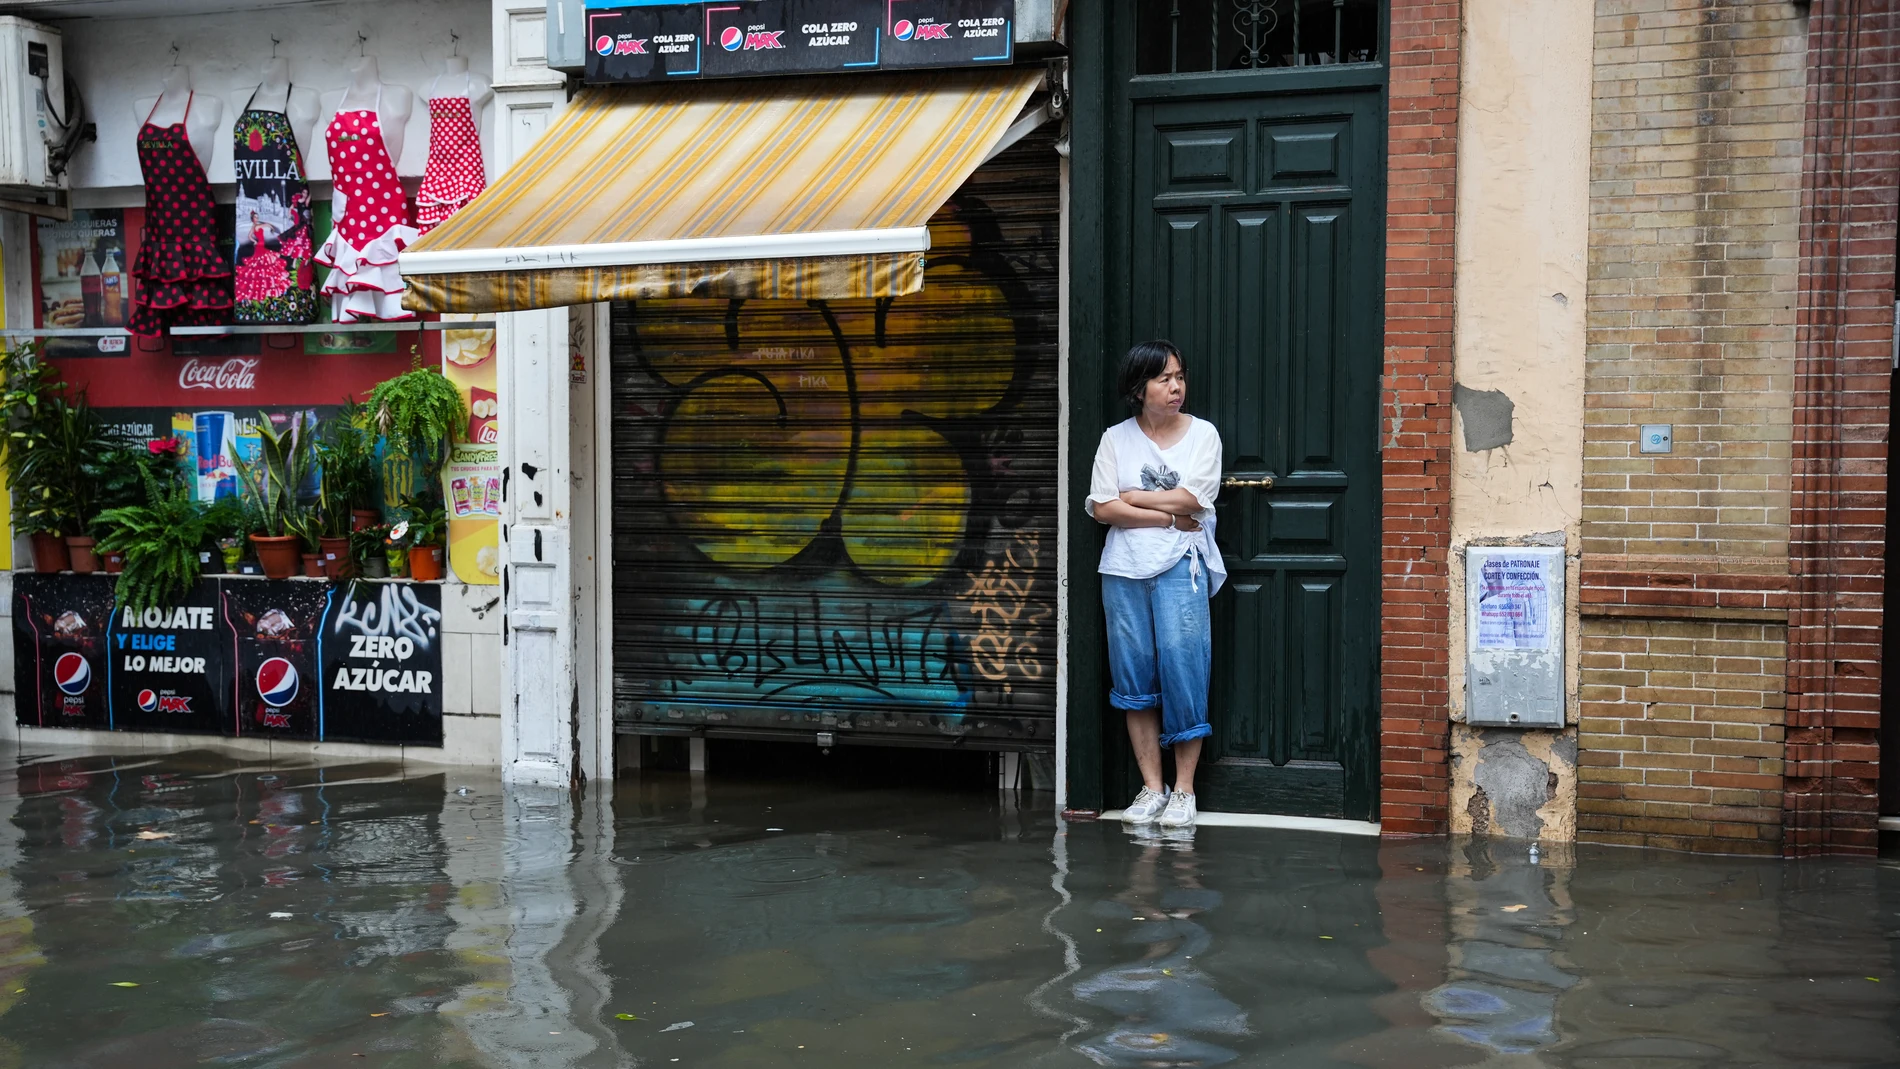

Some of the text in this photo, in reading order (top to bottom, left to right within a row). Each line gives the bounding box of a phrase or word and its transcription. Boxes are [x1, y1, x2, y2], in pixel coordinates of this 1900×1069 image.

[747, 23, 765, 31] pepsi
[802, 22, 858, 34] COLA ZERO
[958, 17, 1005, 28] COLA ZERO
[653, 34, 695, 43] COLA ZERO
[914, 23, 952, 40] MAX
[964, 27, 999, 38] AZÚCAR
[614, 39, 649, 56] MAX
[743, 31, 785, 51] MAX
[808, 34, 850, 47] AZÚCAR
[658, 43, 690, 53] AZÚCAR
[142, 140, 173, 149] SEVILLA
[234, 159, 300, 181] EVILLA
[81, 218, 118, 228] QUIERAS
[78, 228, 116, 237] QUIERAS
[179, 358, 259, 389] Coca-Cola
[798, 374, 829, 388] PIKA
[121, 421, 154, 436] AZÚCAR
[479, 426, 498, 443] La
[198, 454, 235, 468] Red Bu
[452, 447, 498, 464] CANDYFRES
[1503, 560, 1509, 568] de
[1510, 560, 1540, 568] PATRONAJE
[1484, 572, 1500, 580] CORTE
[1501, 572, 1506, 580] Y
[122, 605, 214, 630] MOJATE
[116, 633, 176, 651] Y ELIGE
[349, 635, 414, 660] ZERO
[124, 655, 206, 674] LO MEJOR
[333, 660, 432, 693] AZÚCAR
[63, 696, 84, 705] pepsi
[158, 696, 193, 713] MAX
[264, 714, 292, 728] MAX
